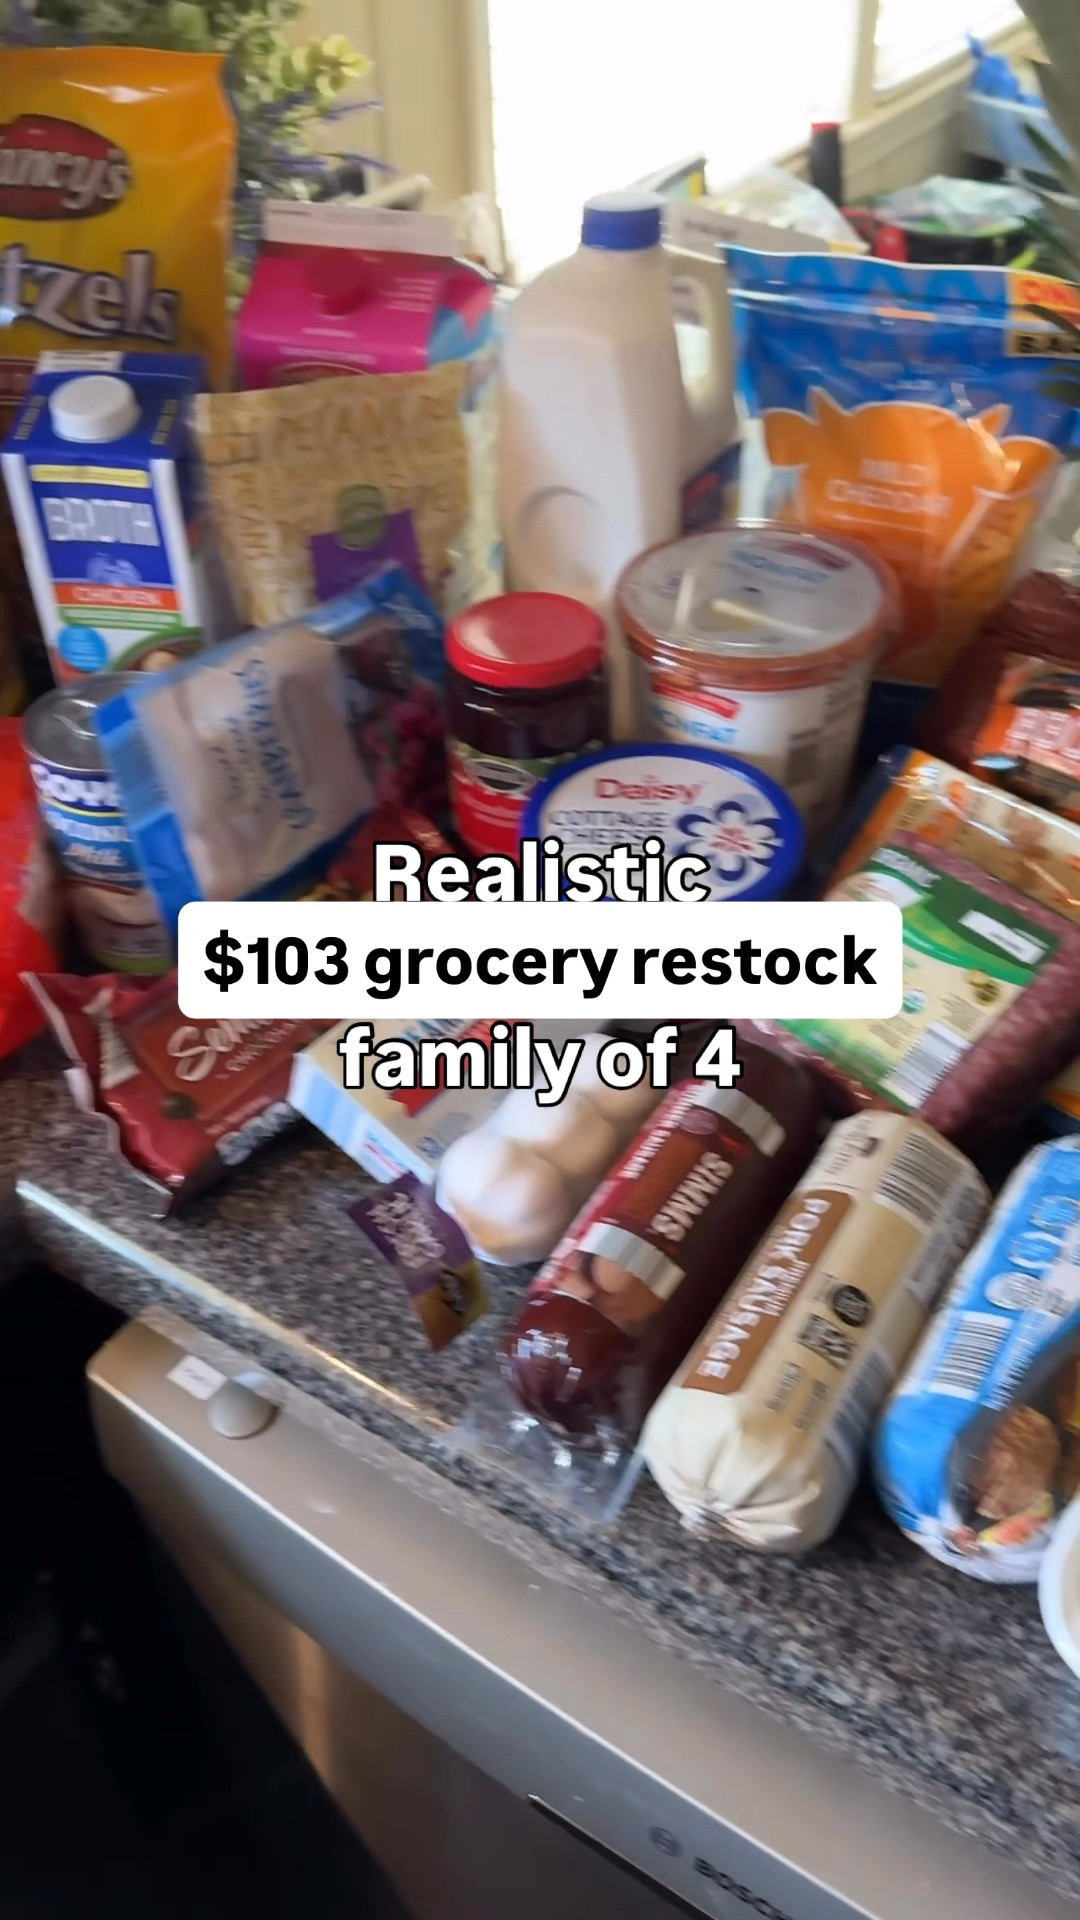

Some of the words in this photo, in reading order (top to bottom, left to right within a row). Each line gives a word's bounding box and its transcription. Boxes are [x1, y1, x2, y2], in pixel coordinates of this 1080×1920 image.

[41, 497, 160, 546] BROTH
[72, 586, 163, 605] CHICKEN
[594, 775, 701, 804] Daisy
[550, 809, 668, 828] COTTAGE
[550, 827, 663, 846] CHEESE
[768, 1198, 831, 1261] PORK
[696, 1264, 790, 1379] SAUSAGE
